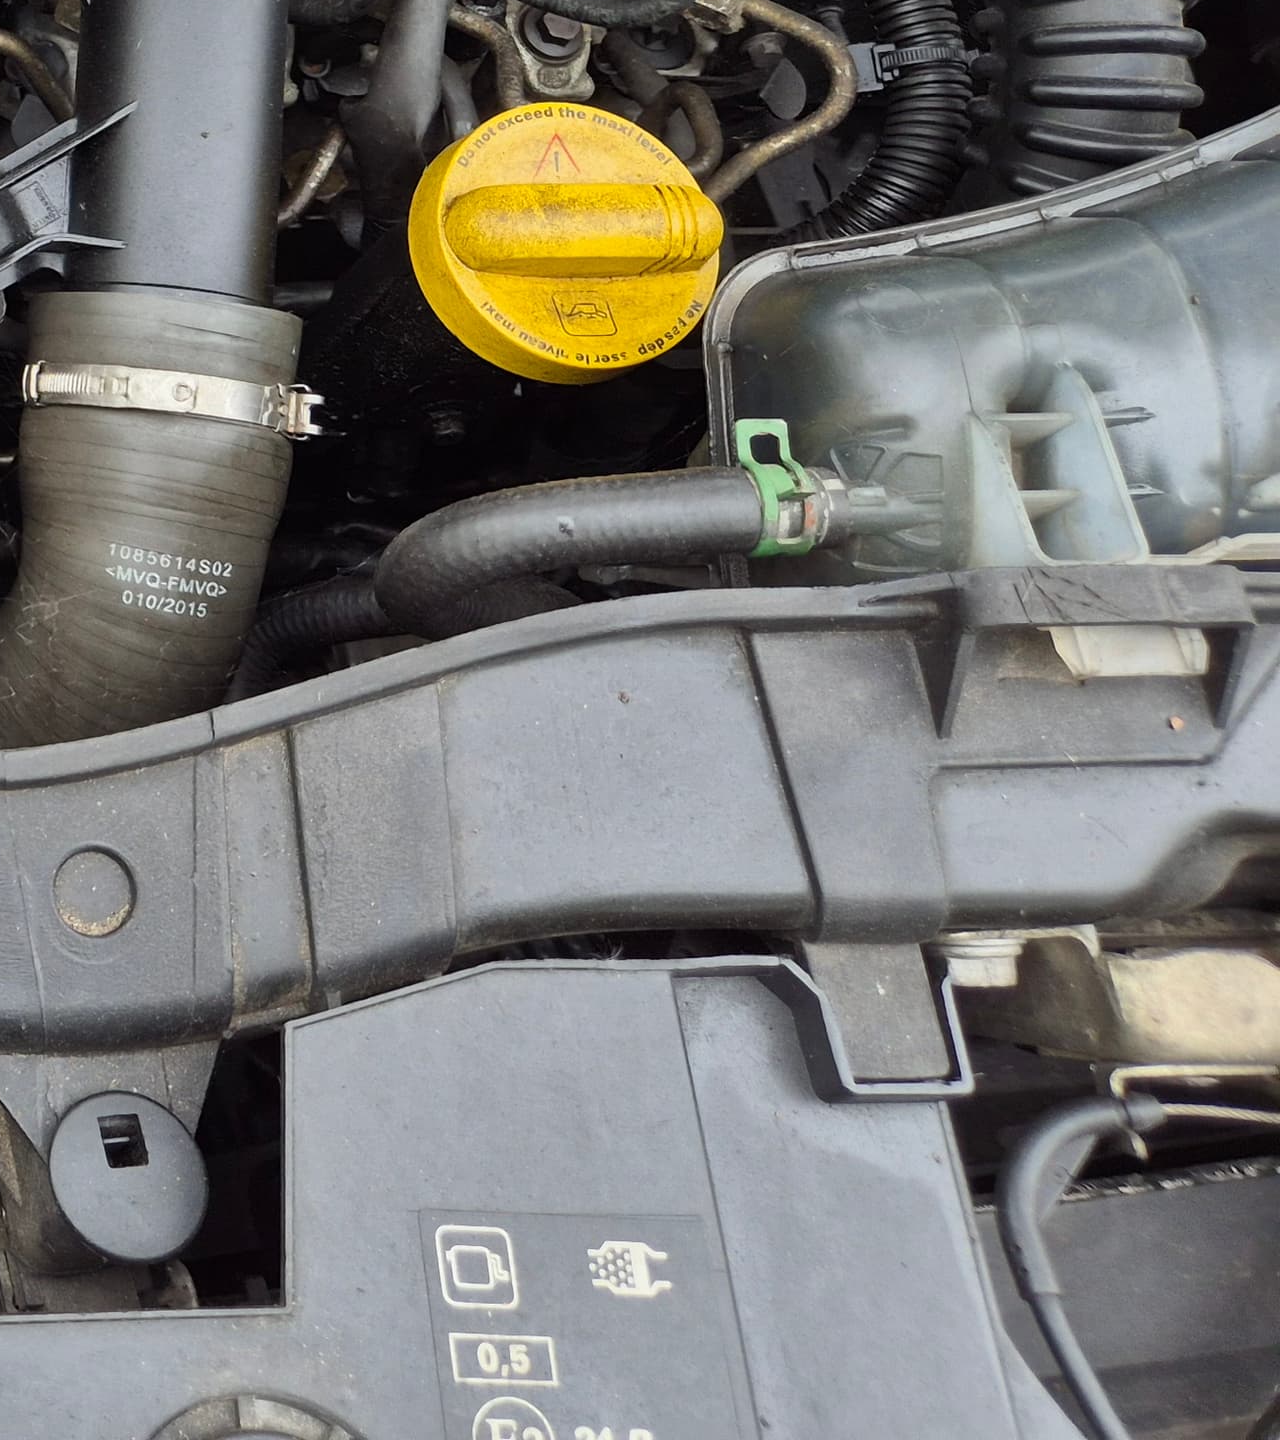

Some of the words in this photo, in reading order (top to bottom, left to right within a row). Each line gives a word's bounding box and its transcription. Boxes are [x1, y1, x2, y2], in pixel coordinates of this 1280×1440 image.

[457, 149, 475, 168] Do
[472, 127, 497, 149] not
[497, 106, 554, 131] exceed
[558, 106, 587, 120] the
[592, 113, 635, 137] maxi
[635, 132, 673, 166] level
[480, 301, 517, 333] maxi
[685, 300, 704, 319] Ne
[575, 352, 590, 365] le
[108, 543, 233, 577] 1085614S02
[104, 565, 228, 598] <MVQ-FMVQ>
[122, 590, 208, 617] 010/2015
[476, 1342, 532, 1377] 0,5
